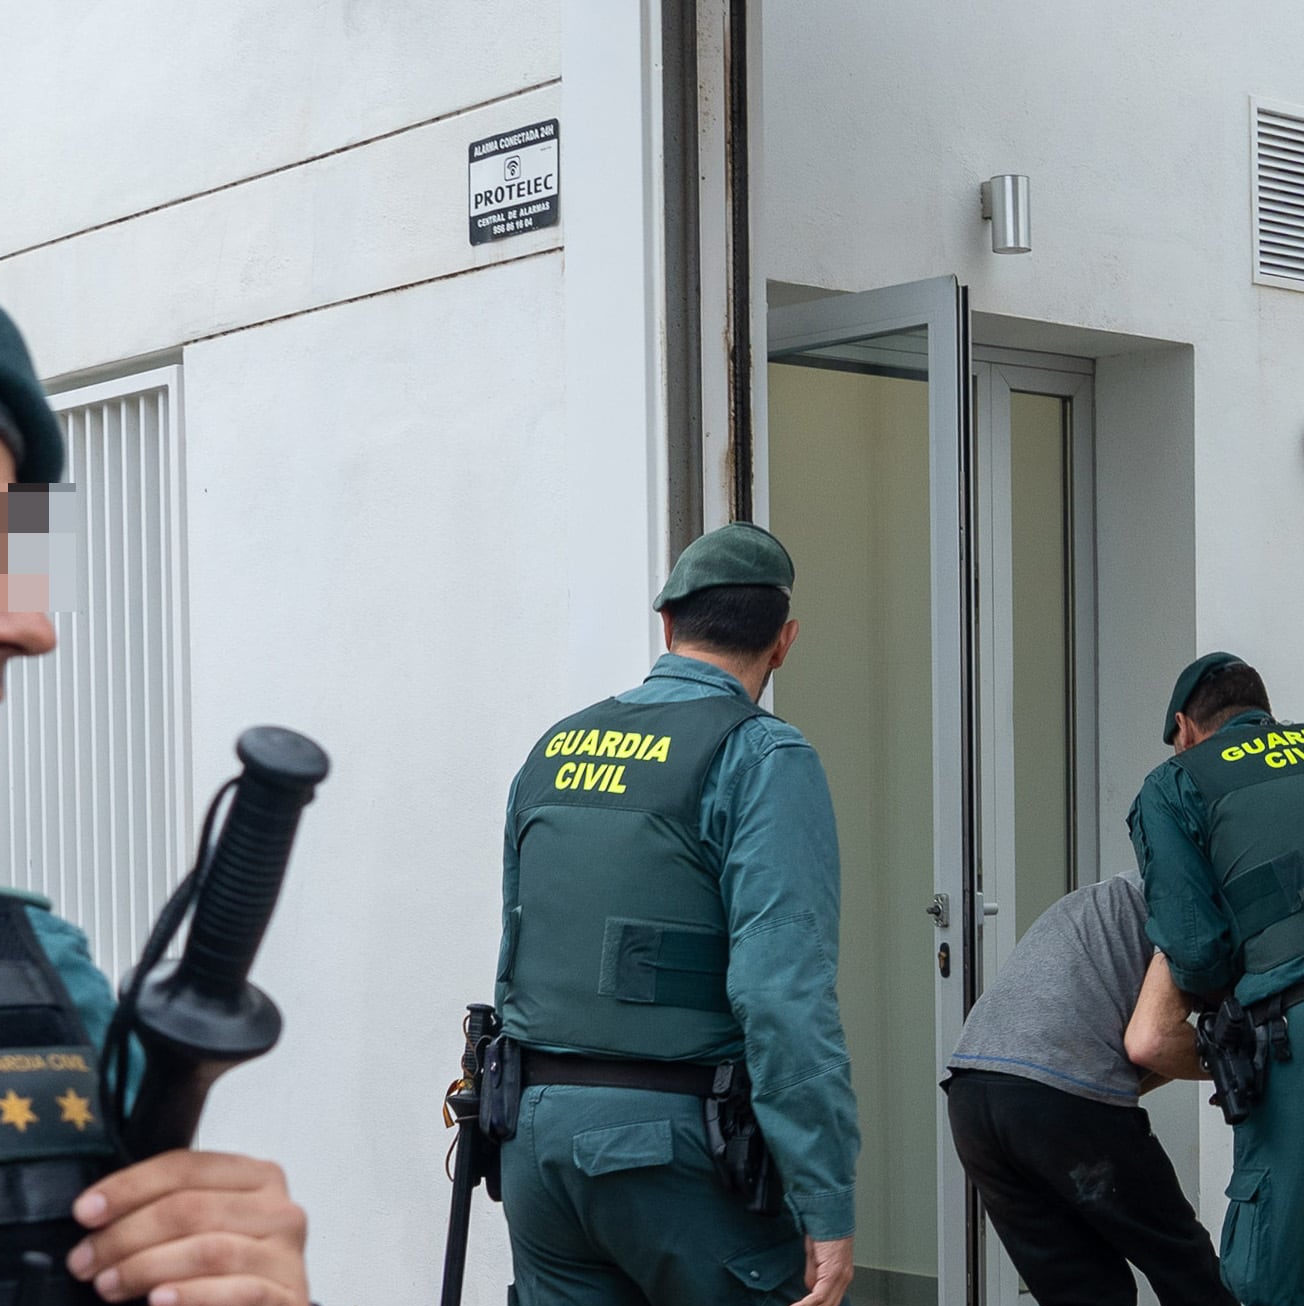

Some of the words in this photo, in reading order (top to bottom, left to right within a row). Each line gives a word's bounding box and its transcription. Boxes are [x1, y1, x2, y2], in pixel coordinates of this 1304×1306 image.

[474, 141, 498, 158] ALARMA
[499, 129, 539, 150] CONECTADA
[540, 124, 554, 139] 24H
[474, 173, 553, 209] PROTELEC
[477, 213, 506, 228] CENTRAL
[508, 209, 518, 221] DE
[519, 201, 550, 217] ALARMAS
[544, 729, 672, 763] GUARDIA
[554, 761, 627, 794] CIVIL
[46, 1053, 90, 1073] CIVIL
